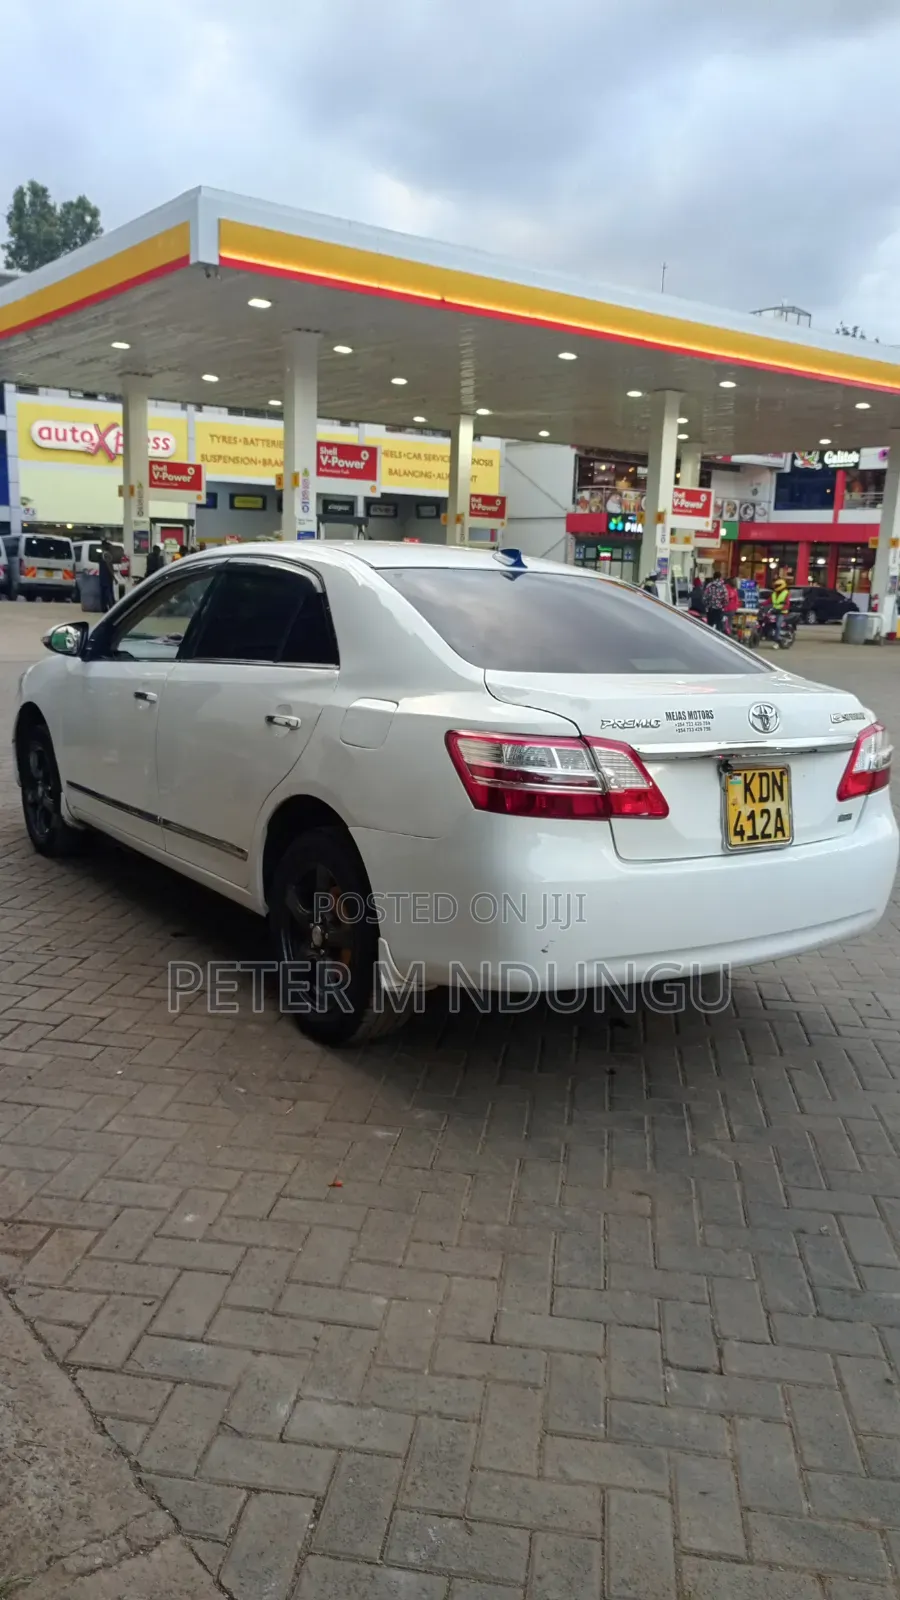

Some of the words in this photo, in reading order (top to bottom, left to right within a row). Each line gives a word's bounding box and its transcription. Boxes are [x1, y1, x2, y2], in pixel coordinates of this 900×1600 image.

[38, 421, 170, 462] autoXpss
[209, 433, 237, 445] TYRES
[243, 437, 285, 449] BATTERIE
[319, 446, 338, 456] Shell
[200, 454, 258, 466] SUSPENSION
[320, 456, 365, 469] V-Power
[407, 452, 421, 461] CAR
[424, 453, 451, 464] SERVIC
[152, 464, 168, 472] Shell
[388, 468, 432, 480] BALANCING
[153, 471, 192, 483] V-Power
[471, 503, 499, 512] V-Power
[673, 498, 704, 509] V-Power
[687, 709, 714, 720] MOTORS
[600, 718, 661, 730] PREMIO
[743, 771, 785, 804] KDN
[733, 808, 786, 841] 412A
